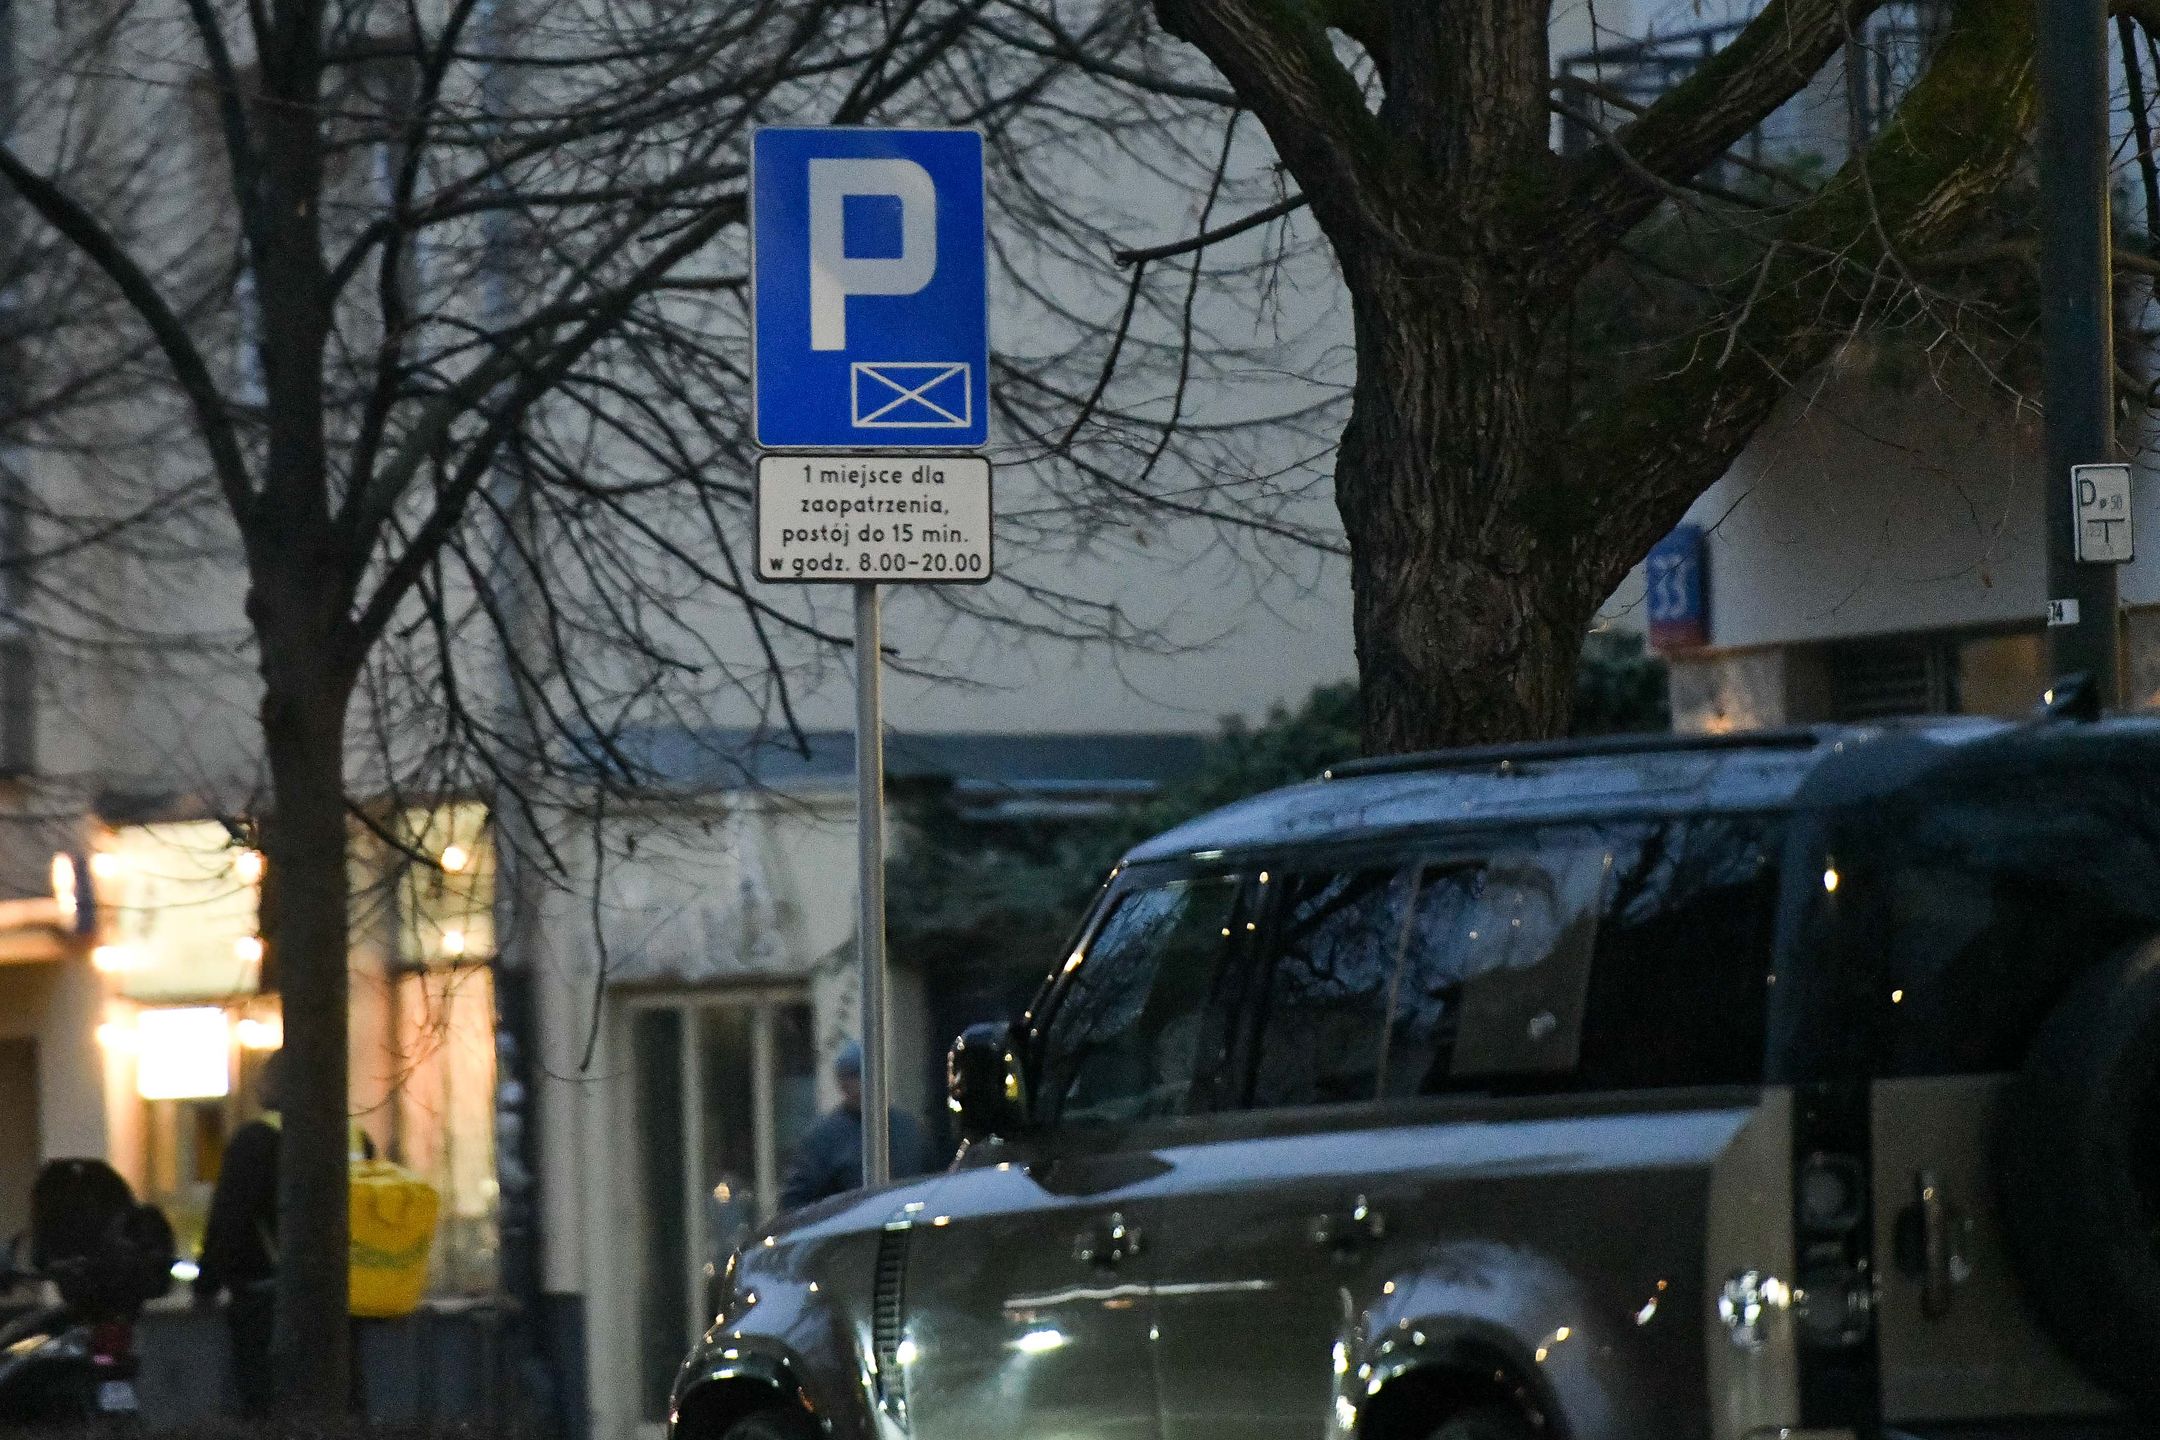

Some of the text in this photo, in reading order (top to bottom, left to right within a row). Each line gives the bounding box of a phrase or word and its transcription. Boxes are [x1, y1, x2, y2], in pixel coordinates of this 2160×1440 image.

[808, 157, 938, 352] P
[803, 464, 945, 488] 1 miejsce dla
[801, 494, 950, 518] zaopatrzenia,
[782, 522, 969, 547] postój do 15 min.
[769, 552, 982, 577] w godz. 8.00-20.00
